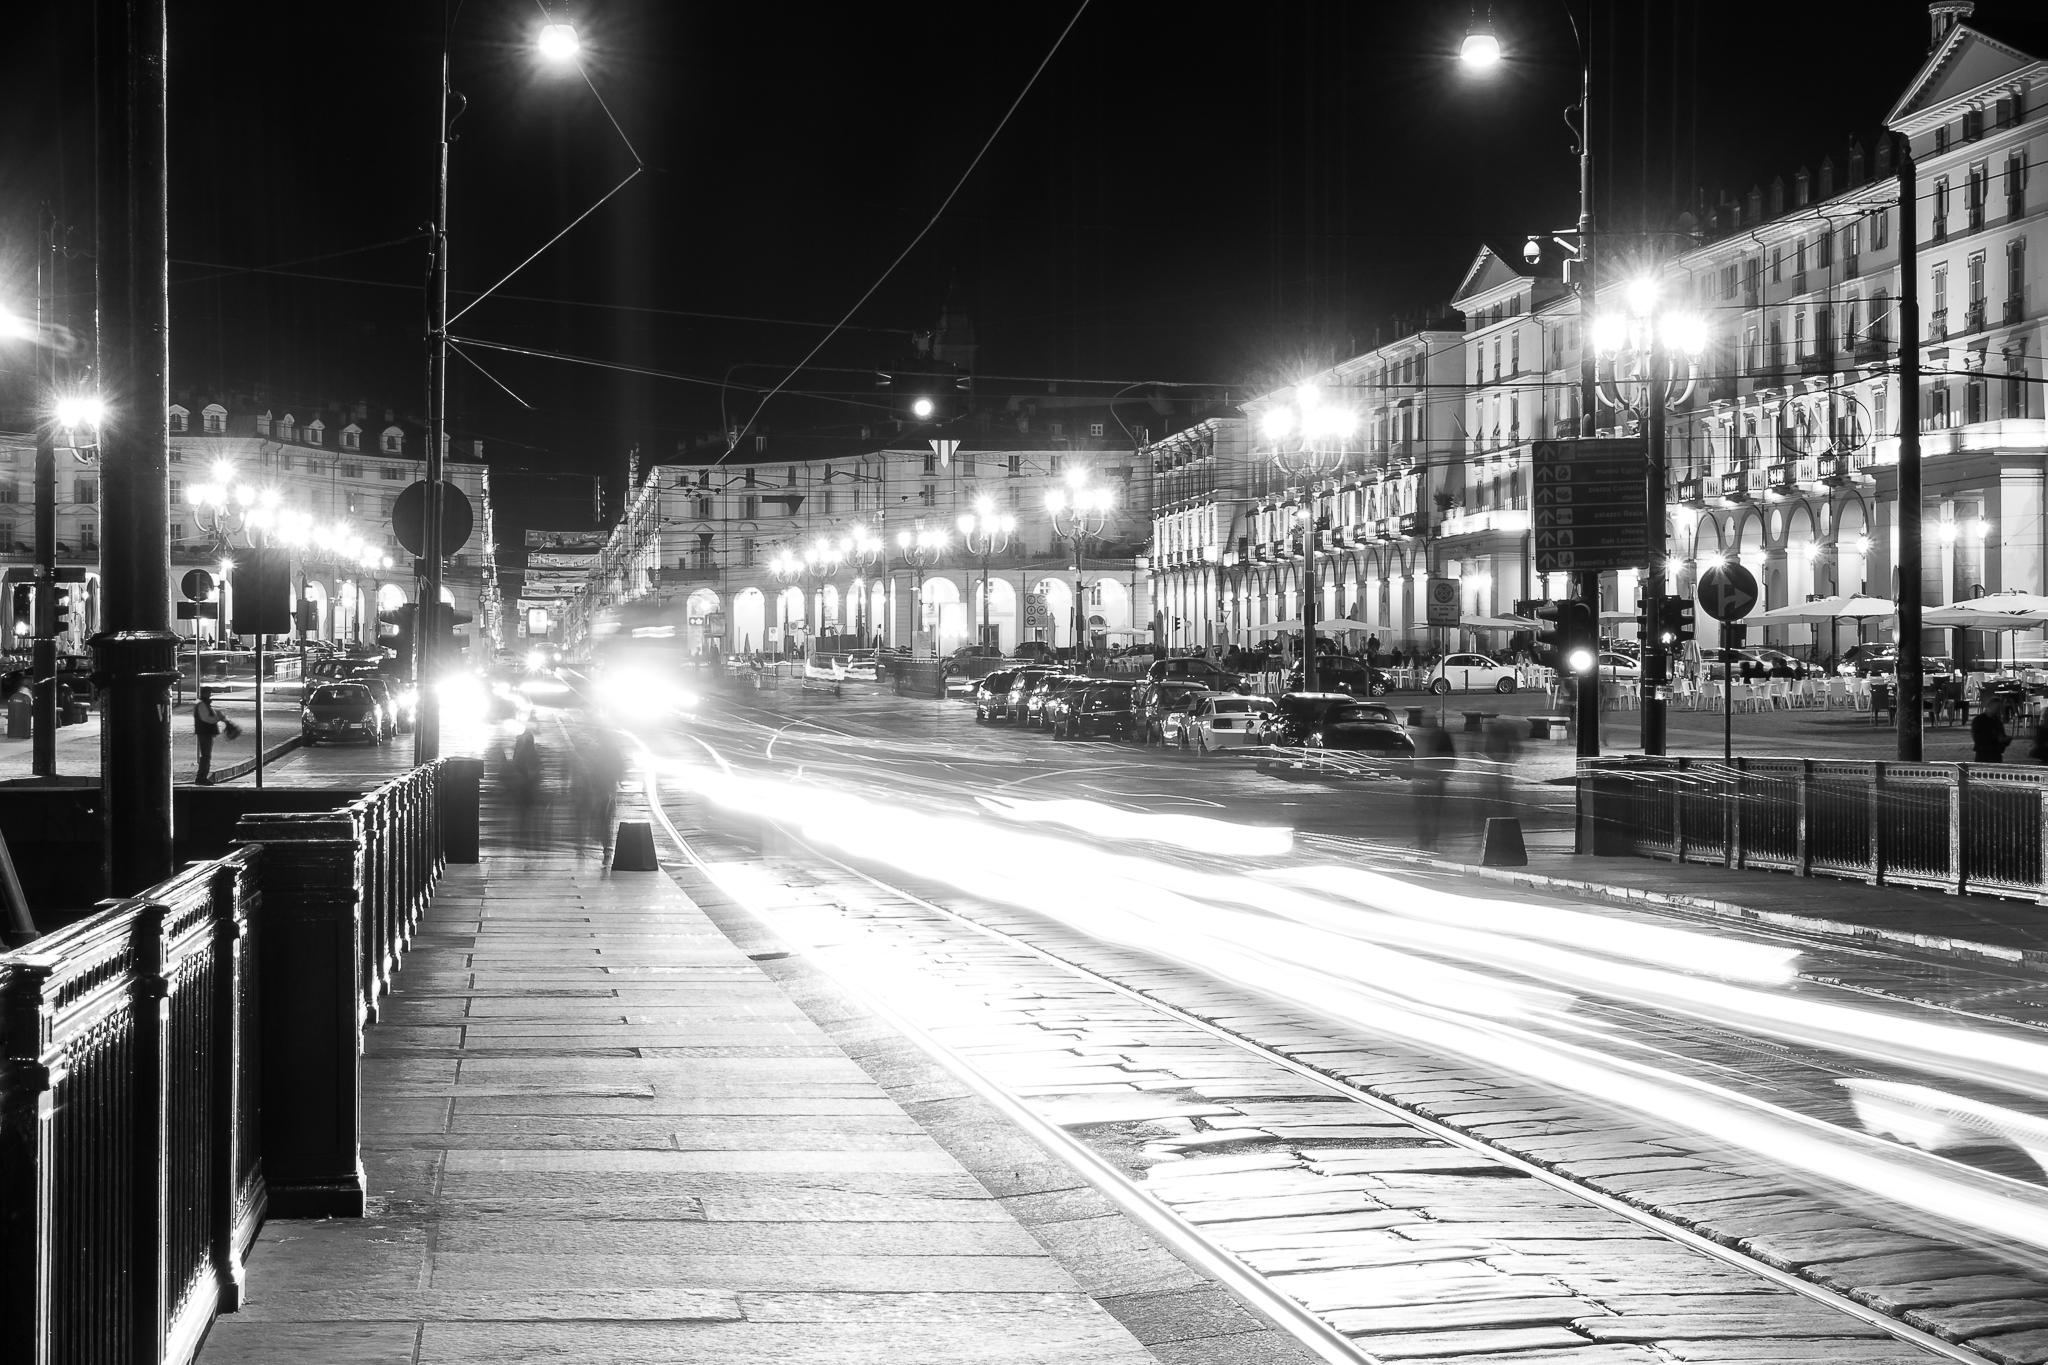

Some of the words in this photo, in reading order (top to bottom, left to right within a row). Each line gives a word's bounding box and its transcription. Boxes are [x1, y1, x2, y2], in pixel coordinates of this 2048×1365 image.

[1620, 467, 1643, 475] Egizio
[1594, 511, 1622, 519] palazzo
[1575, 558, 1606, 567] cappella
